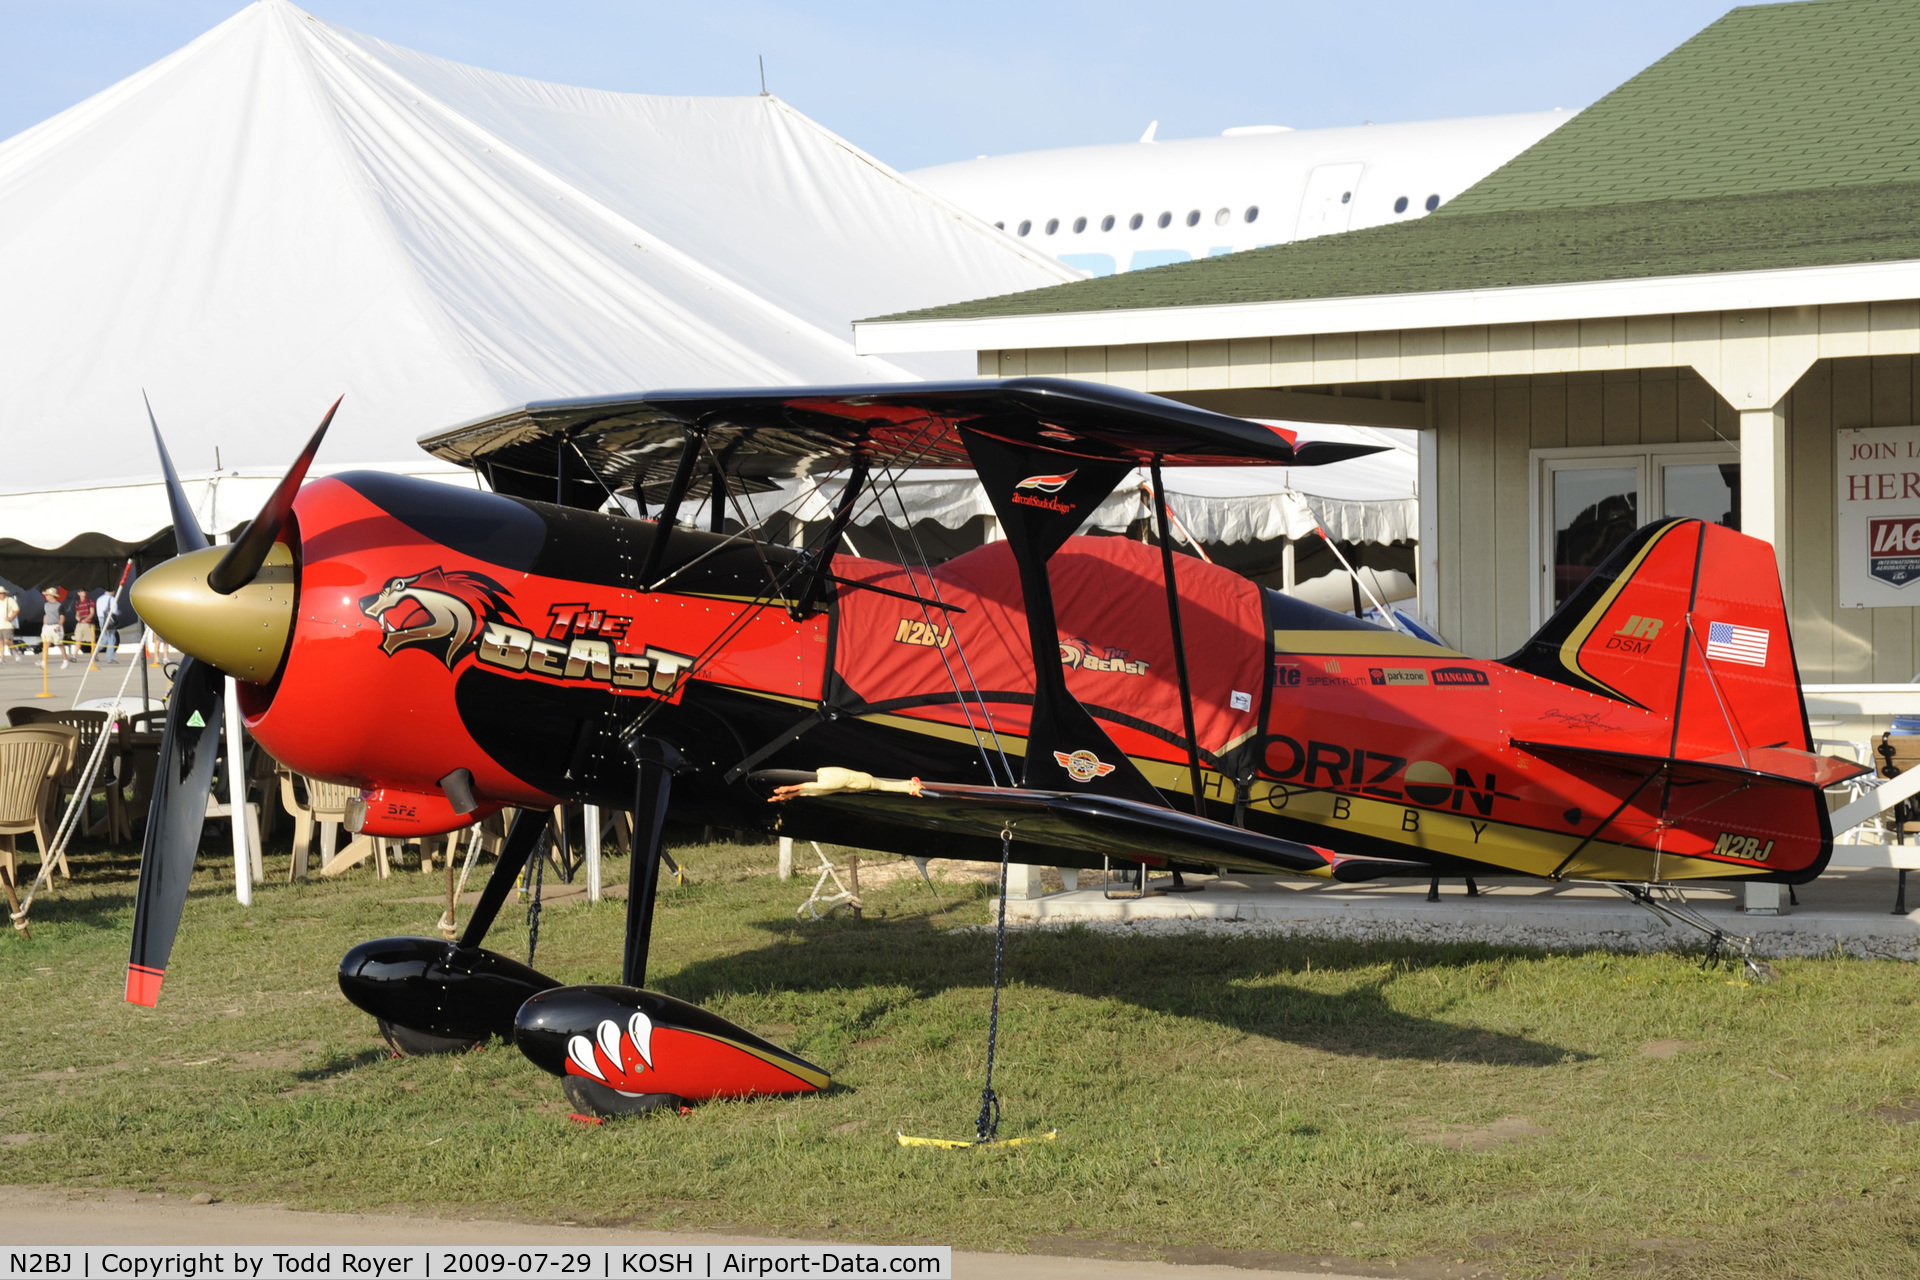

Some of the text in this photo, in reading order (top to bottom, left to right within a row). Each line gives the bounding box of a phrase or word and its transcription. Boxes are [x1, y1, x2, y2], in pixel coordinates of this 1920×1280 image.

[1850, 441, 1920, 460] JOIN I
[1873, 523, 1920, 552] IAC
[894, 618, 953, 649] N2BJ
[1615, 615, 1664, 640] JR
[1606, 637, 1652, 654] DSM
[1273, 666, 1301, 685] ite
[1306, 677, 1367, 686] SPEKTRUM
[1435, 672, 1484, 683] HANGAR 9
[1258, 735, 1497, 816] ORIZON
[1712, 831, 1776, 862] N2BJ
